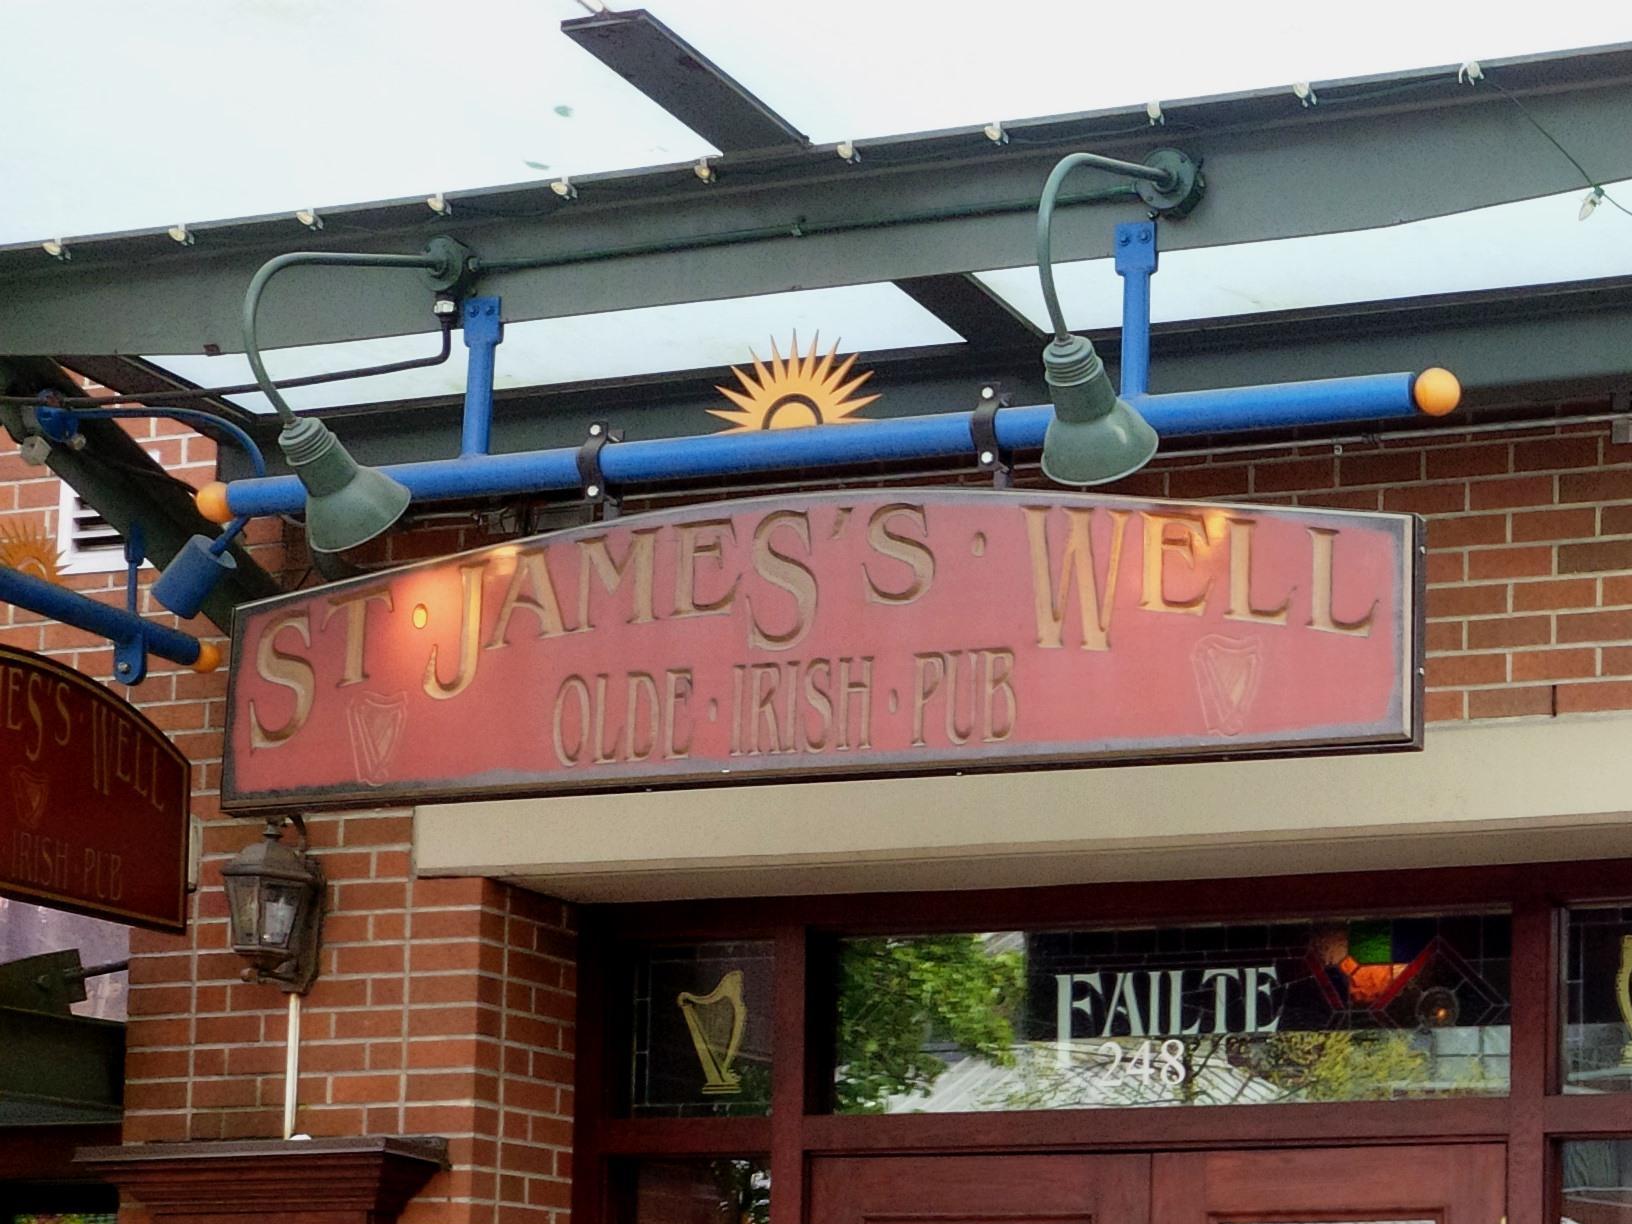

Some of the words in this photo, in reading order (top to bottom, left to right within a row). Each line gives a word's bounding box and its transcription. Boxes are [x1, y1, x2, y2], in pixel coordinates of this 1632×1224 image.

[249, 585, 395, 757] ST
[423, 502, 938, 700] JAMES'S
[1021, 504, 1380, 639] WELL
[0, 663, 72, 762] ES'S
[552, 667, 695, 768] OLDE
[729, 655, 875, 758] IRISH
[910, 646, 1018, 747] PUB
[10, 828, 69, 892] IRISH
[83, 846, 122, 902] PUB
[1054, 966, 1281, 1069] FAILTE
[1098, 1039, 1187, 1088] 248
